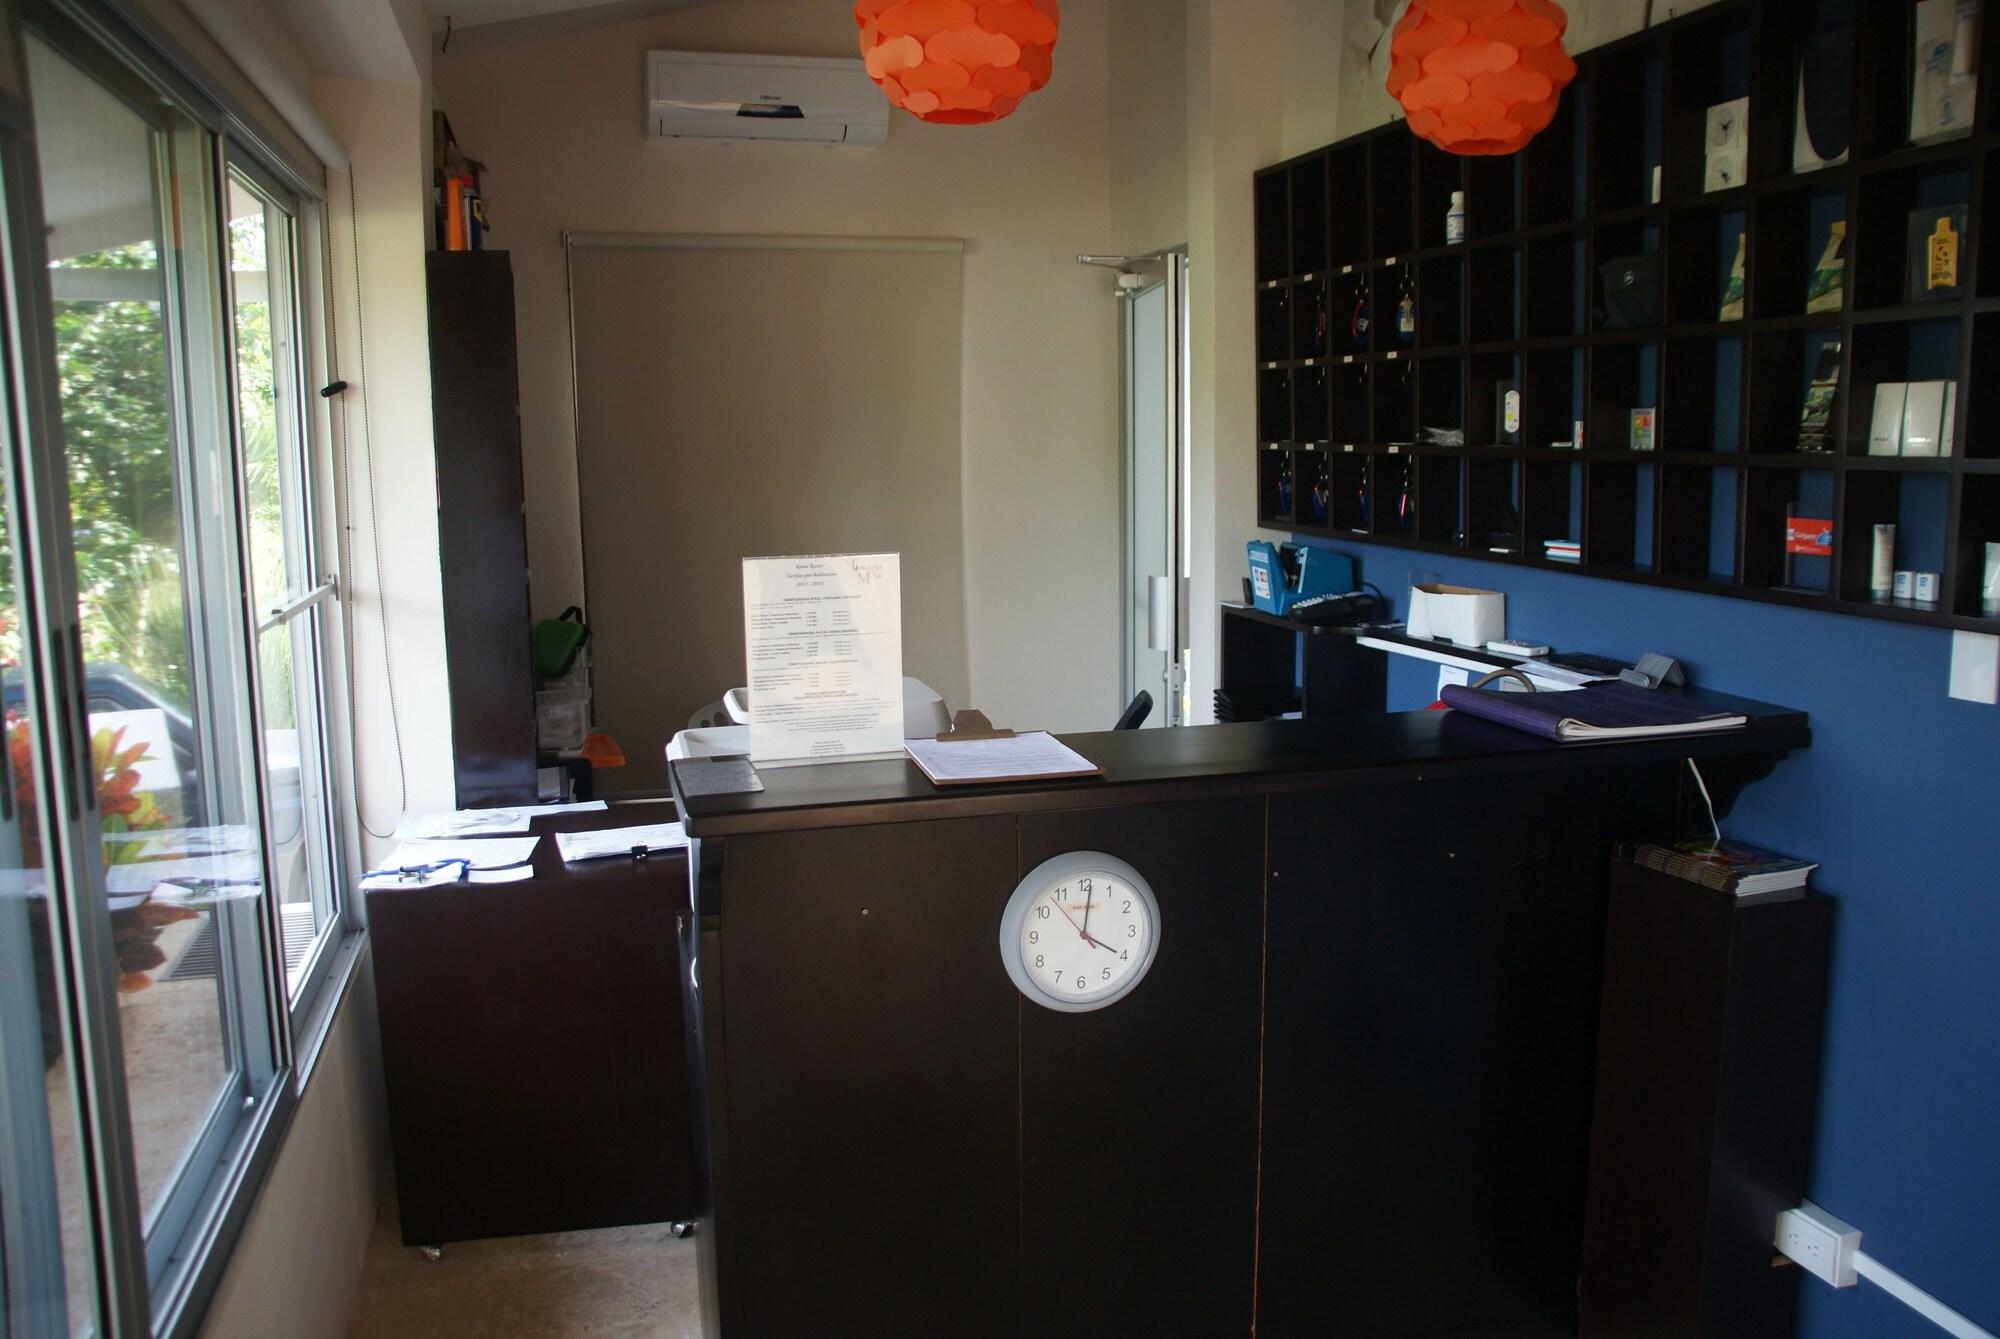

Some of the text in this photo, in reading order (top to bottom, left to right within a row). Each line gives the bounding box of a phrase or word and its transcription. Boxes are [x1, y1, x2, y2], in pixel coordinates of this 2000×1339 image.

[1078, 878, 1092, 892] 12
[1054, 887, 1068, 901] 11
[1106, 886, 1112, 898] 1
[1035, 905, 1050, 919] 10
[1122, 900, 1131, 914] 2
[1029, 931, 1039, 944] 9
[1127, 924, 1136, 938] 3
[1035, 954, 1045, 968] 8
[1119, 949, 1128, 962] 4
[1054, 970, 1064, 983] 7
[1102, 967, 1111, 980] 5
[1076, 976, 1086, 989] 6
